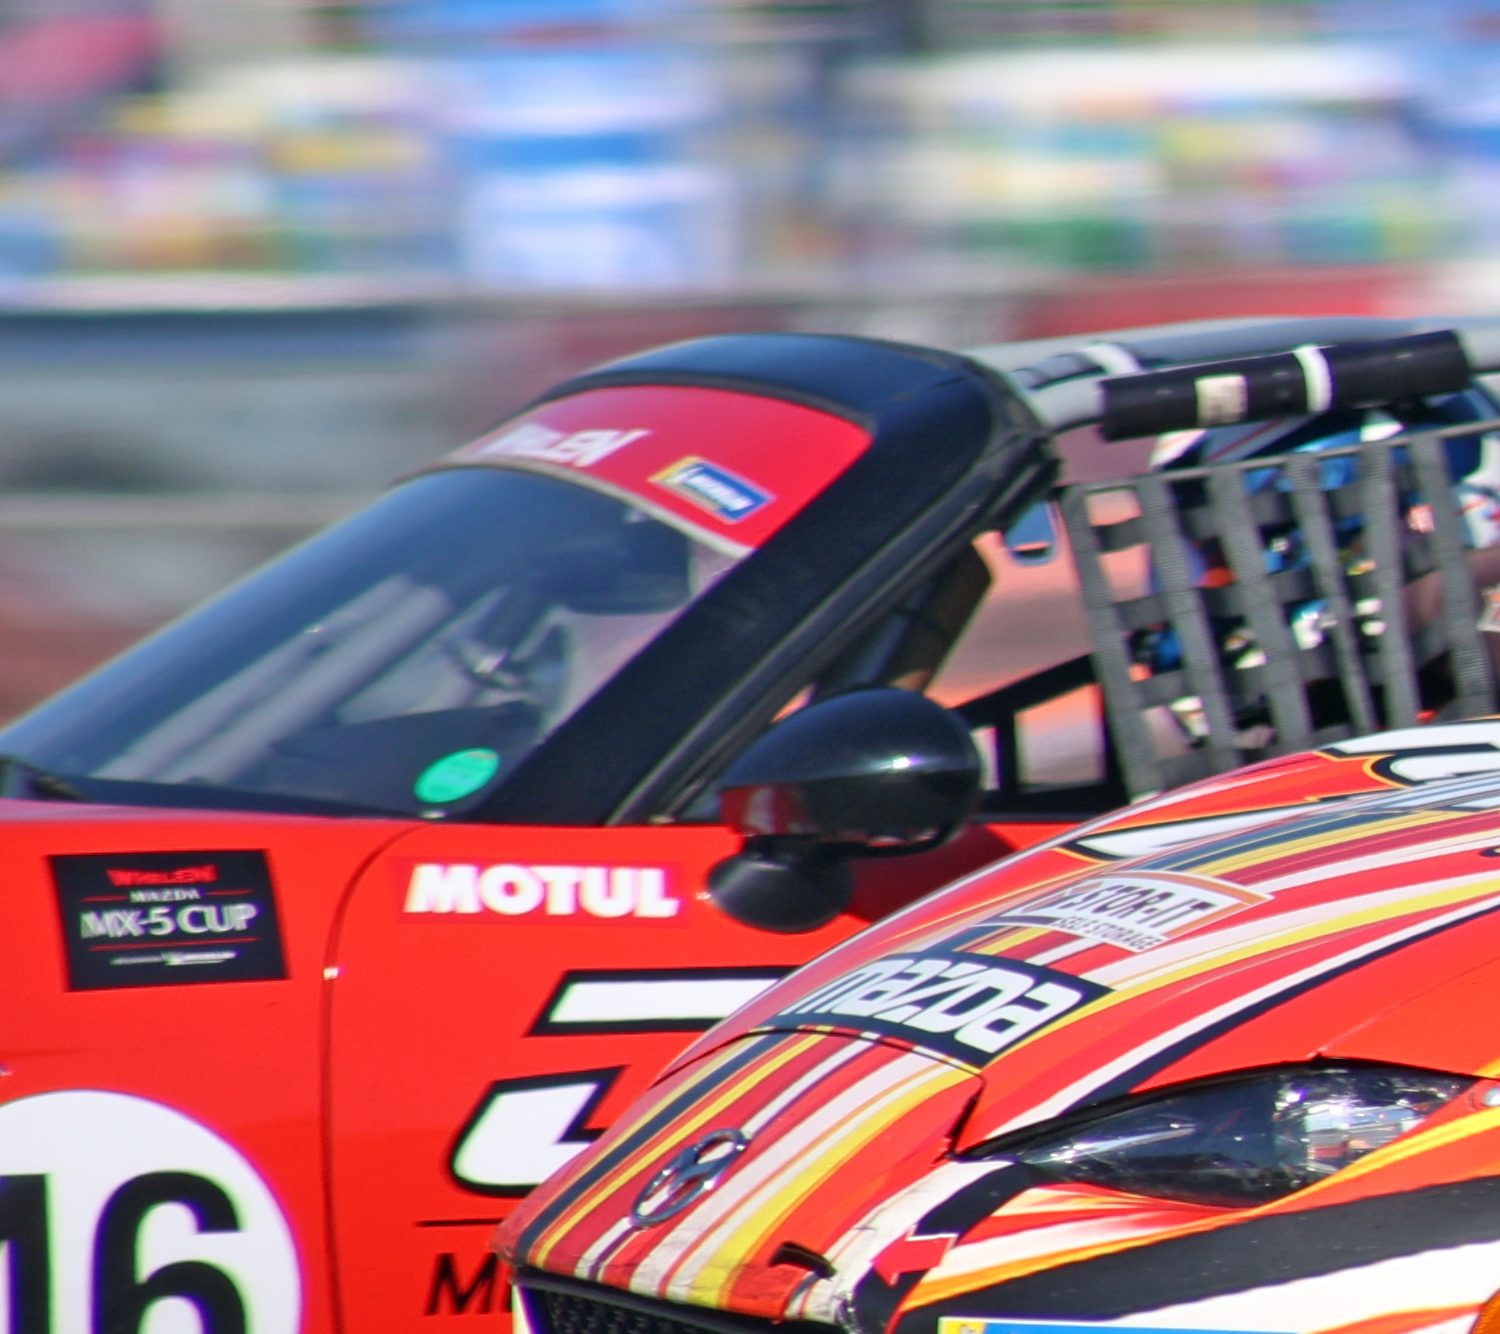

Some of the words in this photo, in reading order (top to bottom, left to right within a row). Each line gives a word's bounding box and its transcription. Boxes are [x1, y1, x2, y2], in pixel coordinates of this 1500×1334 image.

[403, 863, 681, 918] MOTUL
[1057, 884, 1219, 929] STOR-IT
[80, 906, 177, 940] MX-5
[176, 903, 259, 934] CUP
